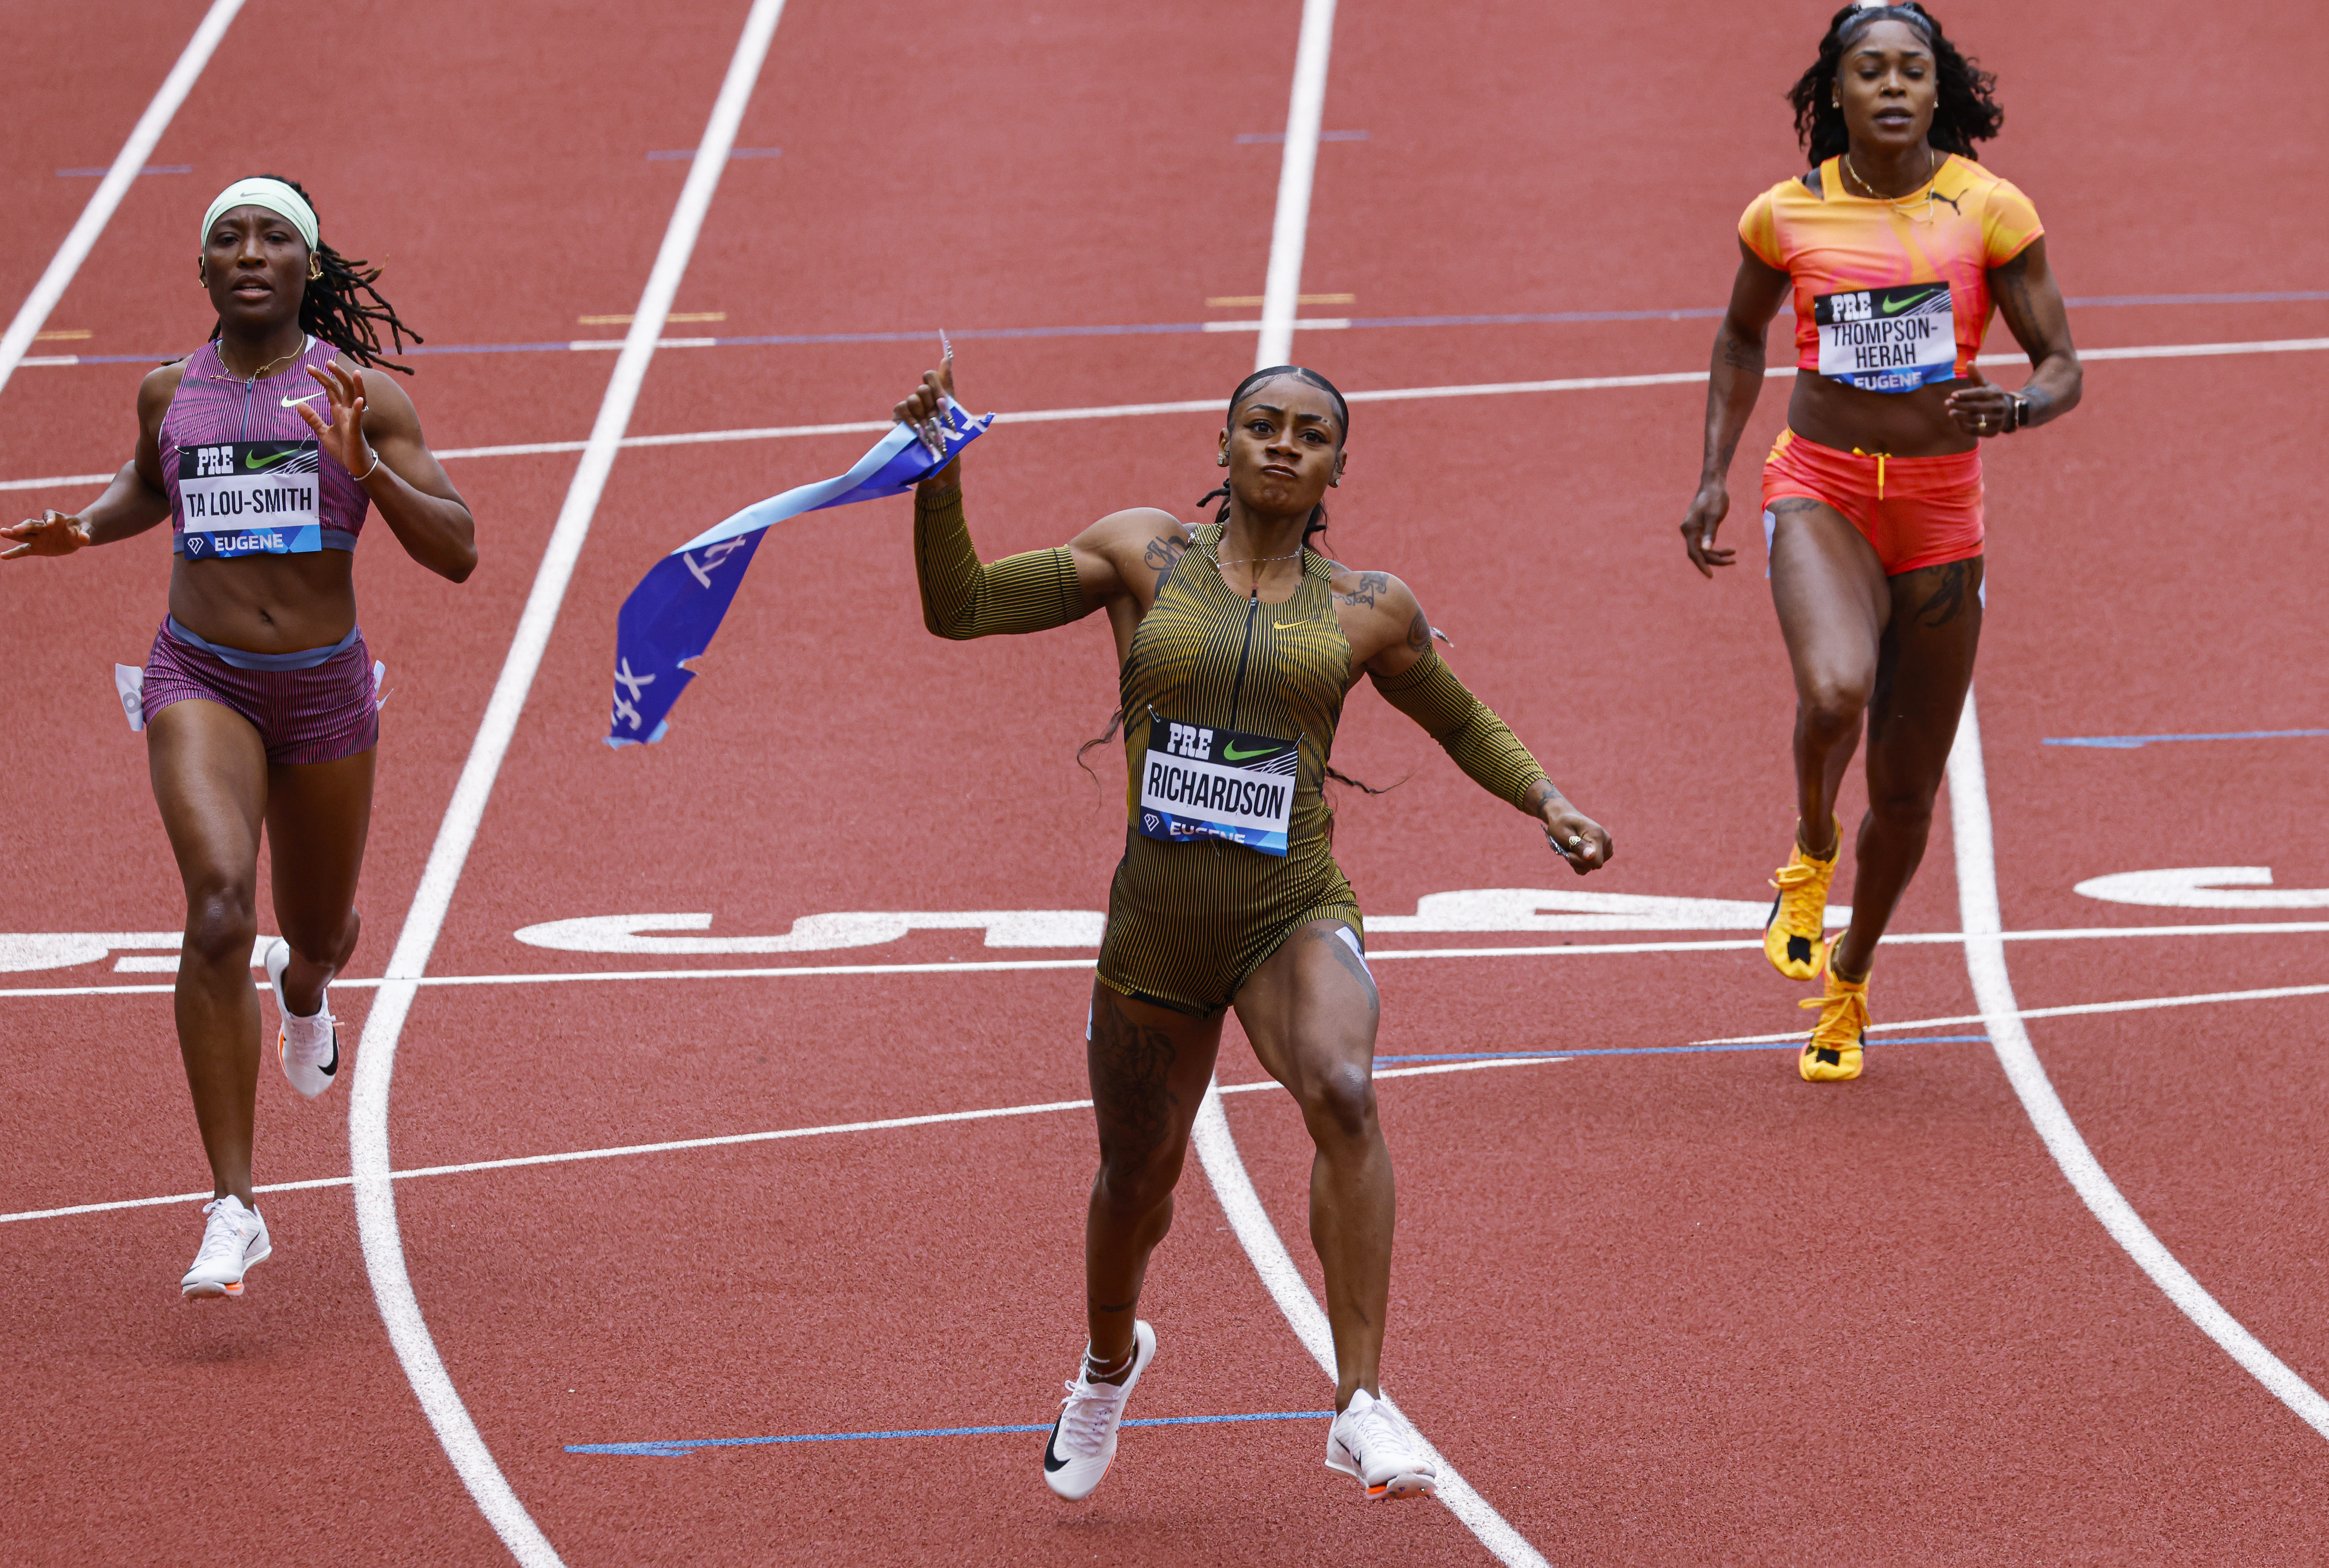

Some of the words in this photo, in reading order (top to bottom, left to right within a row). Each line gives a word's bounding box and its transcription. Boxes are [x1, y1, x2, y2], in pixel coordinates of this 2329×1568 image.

[1831, 292, 1872, 322] PRE
[1832, 317, 1938, 346] THOMPSON-
[1856, 343, 1917, 368] HERAH
[1854, 372, 1922, 390] EUGENE
[197, 446, 233, 476] PRE
[186, 493, 205, 517] TA
[211, 487, 312, 516] LOU-SMITH
[215, 534, 284, 551] EUGENE
[1167, 722, 1213, 760] PRE
[1148, 762, 1285, 819] RICHARDSON
